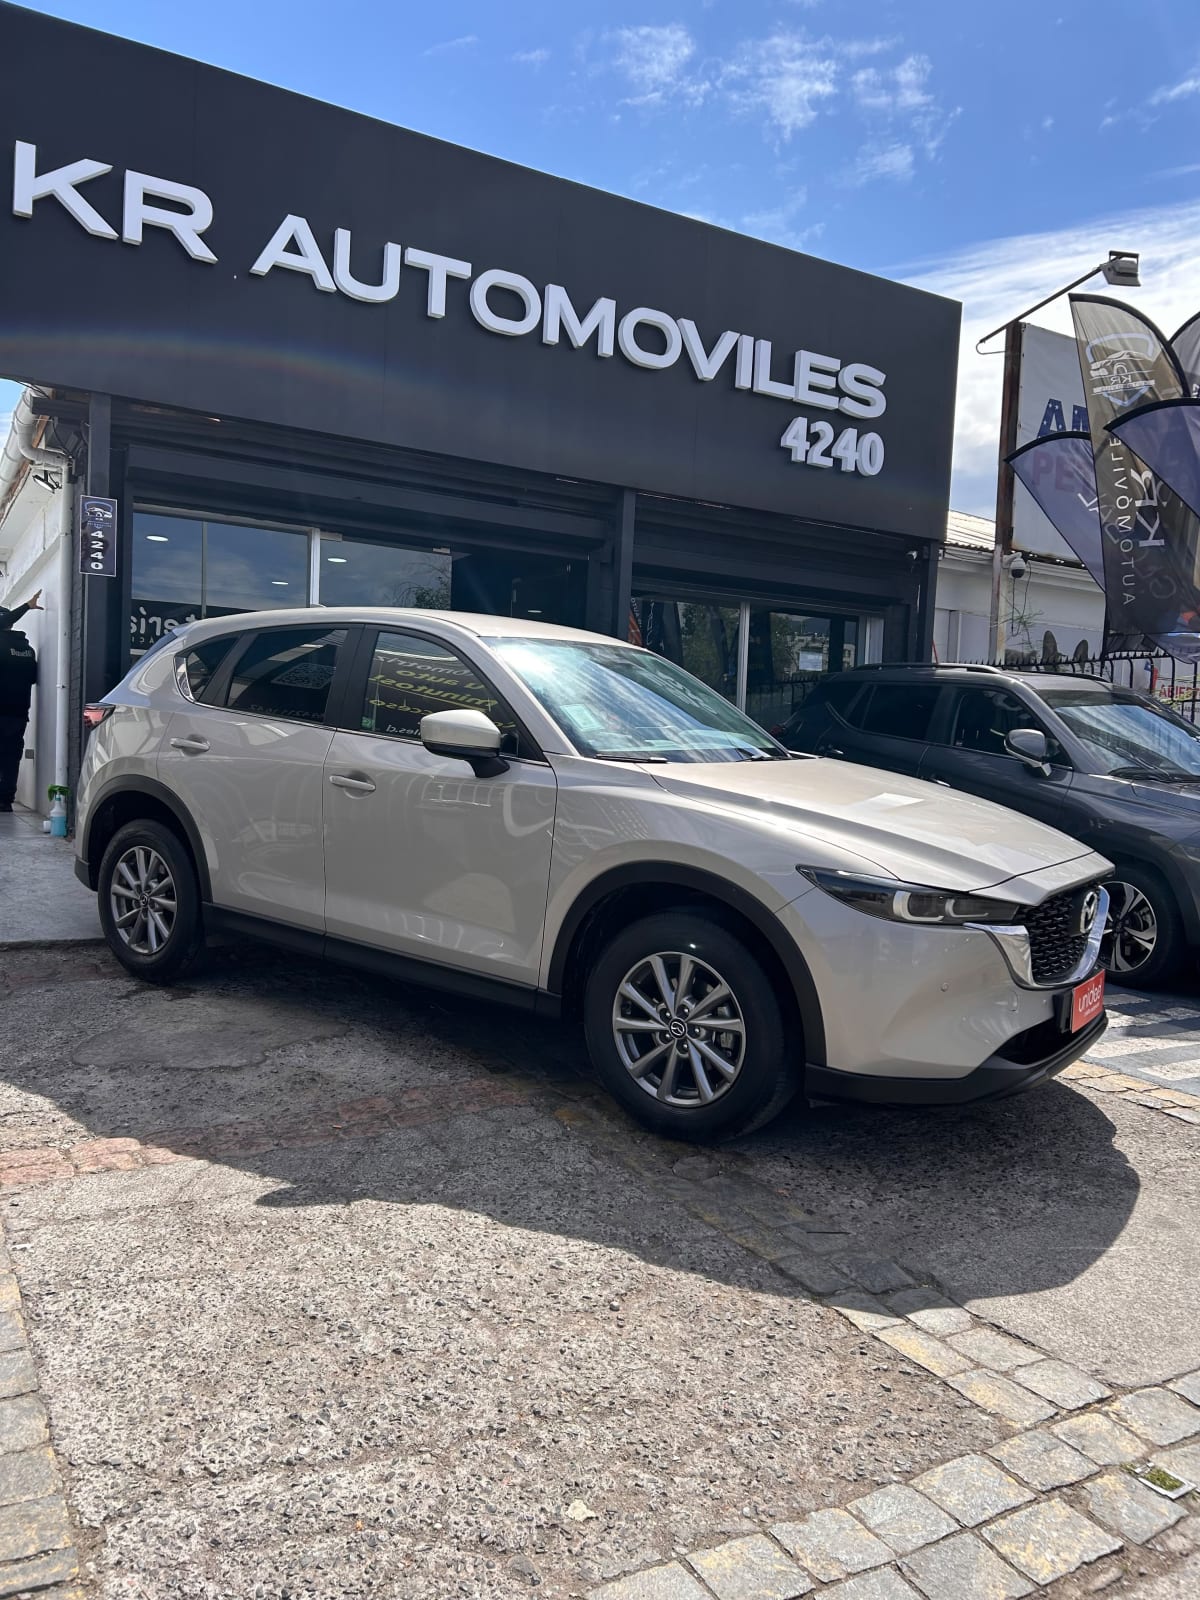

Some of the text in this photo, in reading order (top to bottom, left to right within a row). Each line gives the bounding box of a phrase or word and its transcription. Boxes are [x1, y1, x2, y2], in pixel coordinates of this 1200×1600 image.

[12, 139, 887, 420] KR AUTOMOVILES
[780, 417, 886, 477] 4240
[90, 530, 105, 570] 4240
